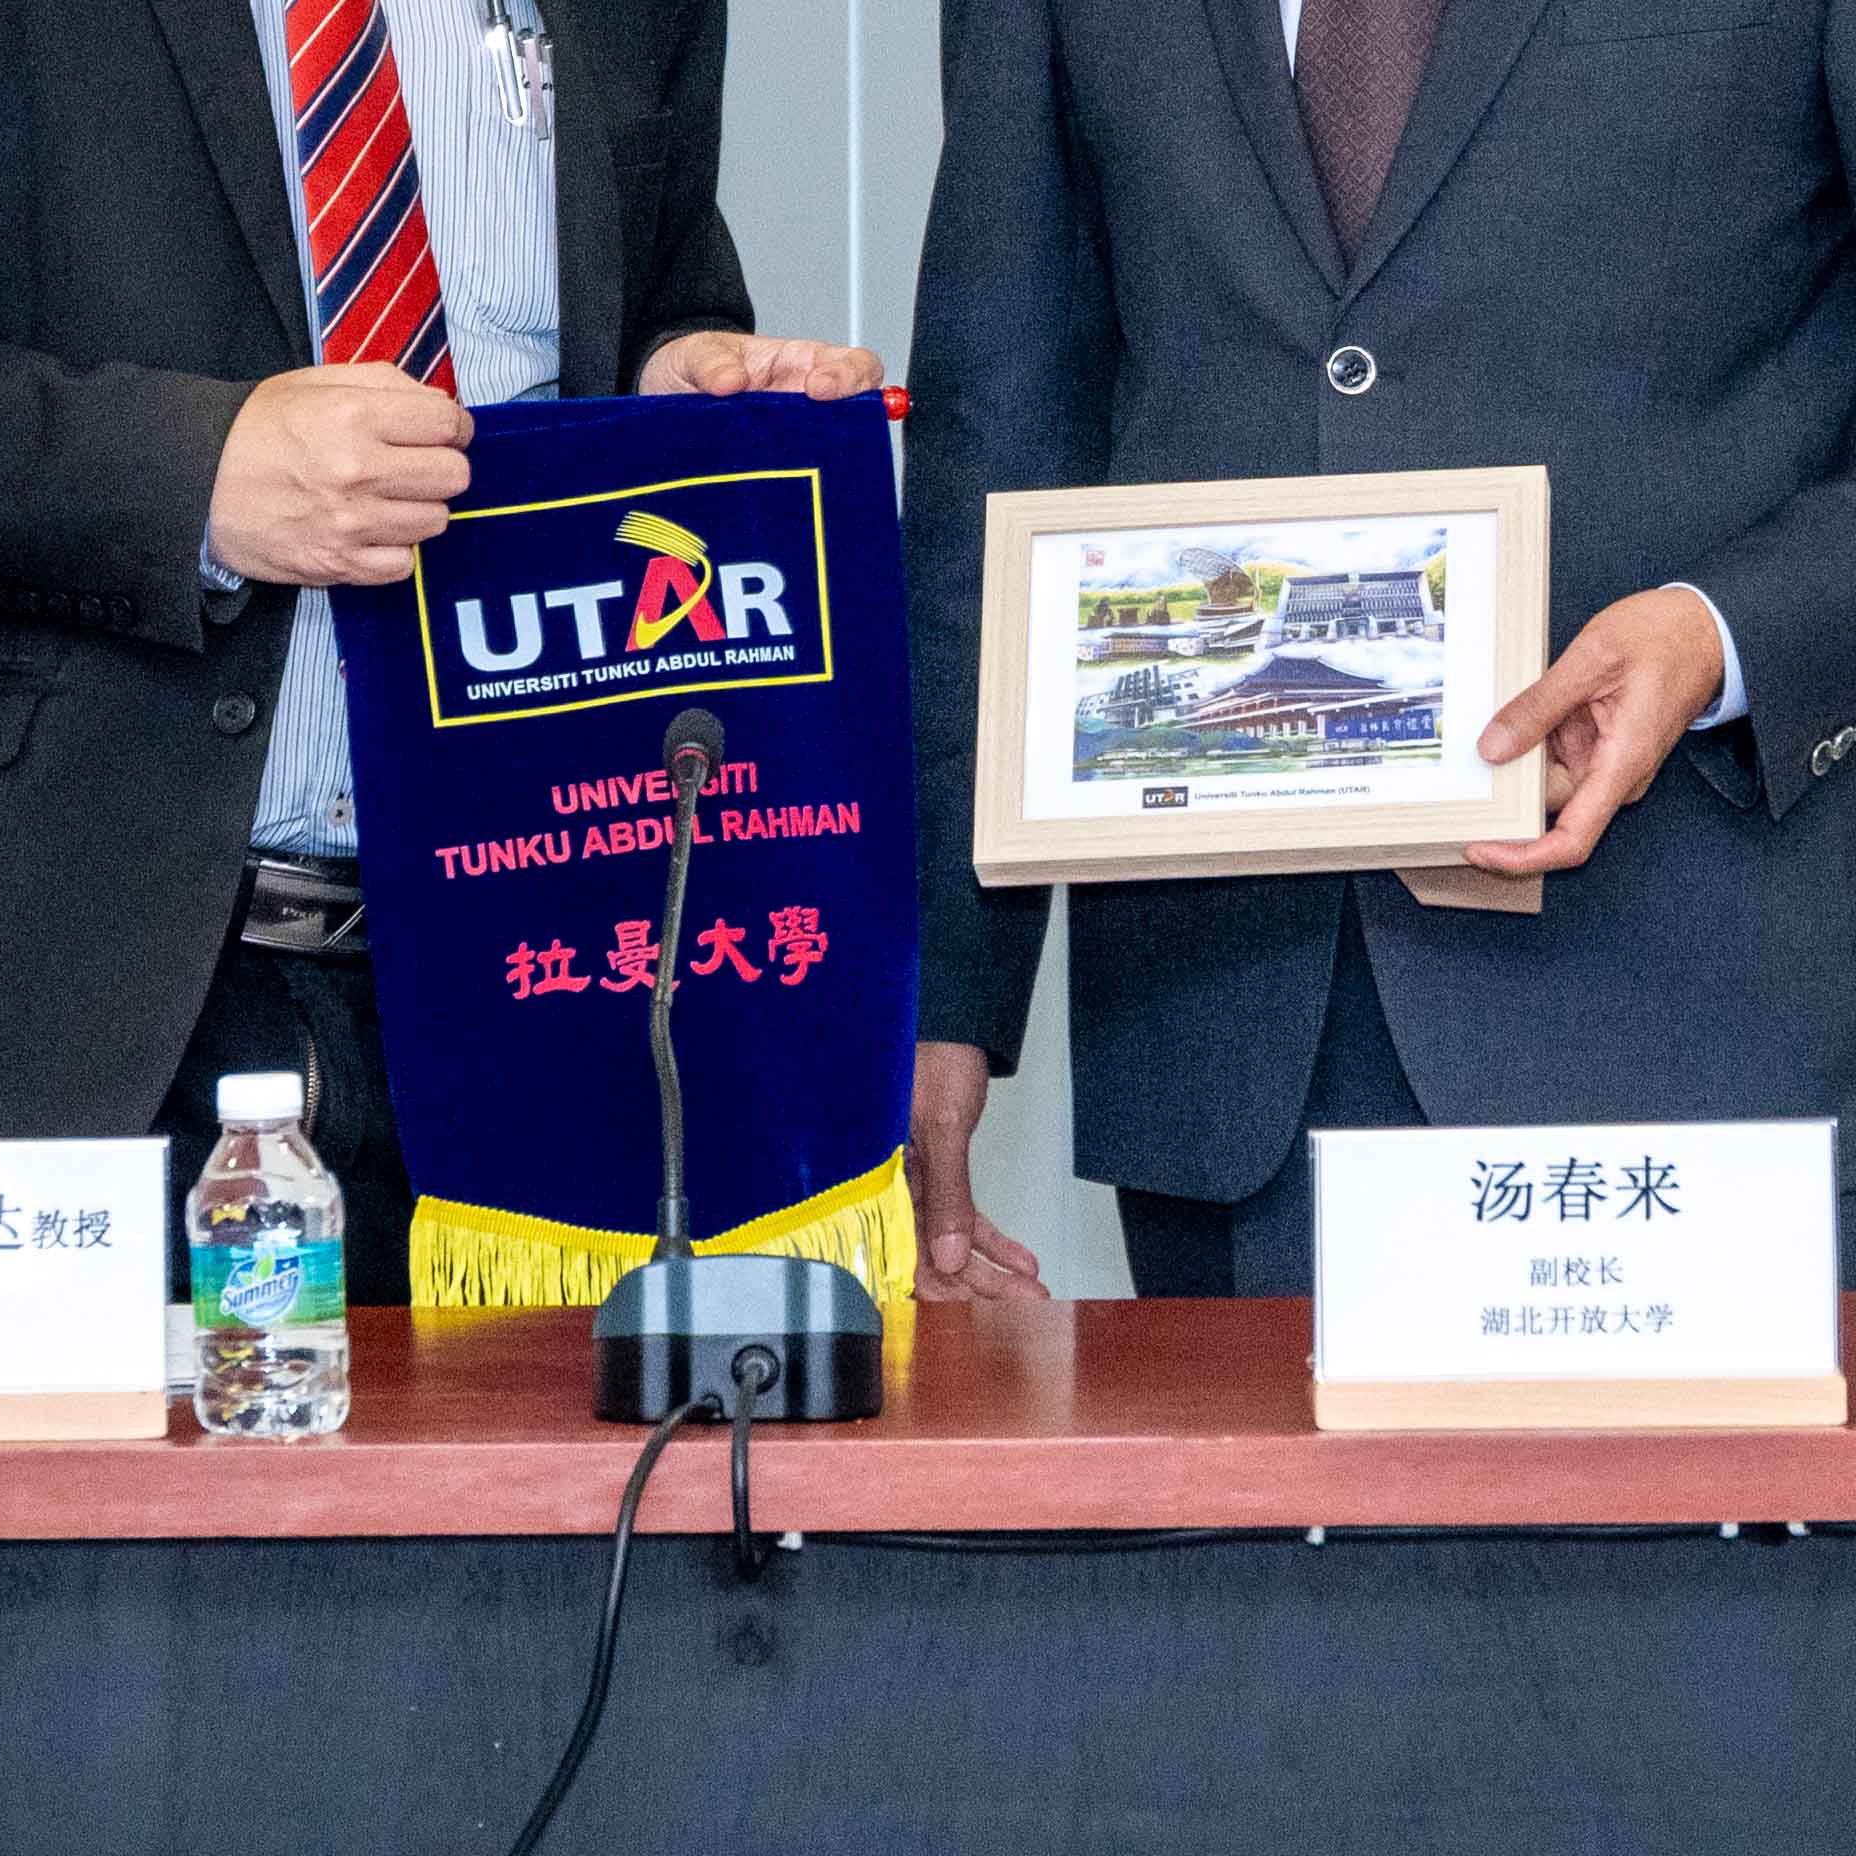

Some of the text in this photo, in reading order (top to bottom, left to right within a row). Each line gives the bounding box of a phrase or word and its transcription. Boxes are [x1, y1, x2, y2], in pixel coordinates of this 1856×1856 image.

[455, 554, 794, 673] UTAR
[466, 644, 795, 701] UNIVERSITI TUNKU ABDUL RAHMAN
[434, 831, 572, 879] TUNKU
[720, 801, 862, 842] RAHMAN
[505, 905, 829, 1001] 拉曼大學
[1470, 1154, 1681, 1223] 汤春来
[220, 1270, 298, 1313] Summer
[1528, 1255, 1624, 1288] 副校长
[1479, 1302, 1675, 1337] 湖北开放大学
